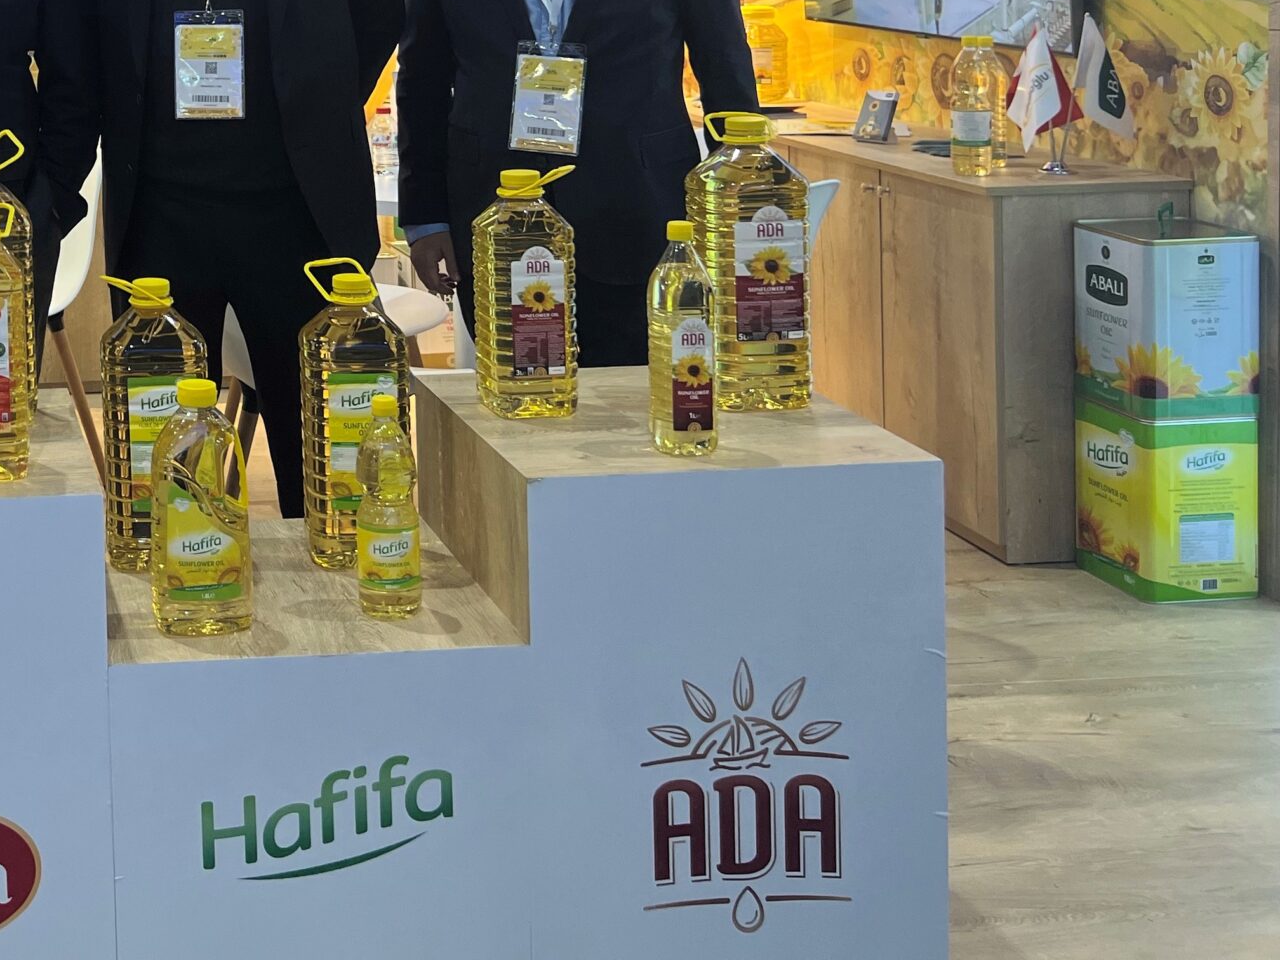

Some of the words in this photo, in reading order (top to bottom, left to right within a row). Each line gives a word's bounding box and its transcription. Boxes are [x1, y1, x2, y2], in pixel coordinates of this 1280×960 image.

[756, 222, 784, 238] ADA
[526, 260, 550, 274] ADA
[1089, 273, 1124, 297] ABALI
[681, 332, 705, 346] ADA
[140, 390, 179, 410] Hafif
[1087, 441, 1129, 466] Hafifa
[1186, 450, 1226, 469] Hafifa
[182, 535, 222, 553] Hafifa
[372, 539, 409, 555] Hafifa
[201, 755, 455, 871] Hafifa
[650, 772, 844, 888] ADA
